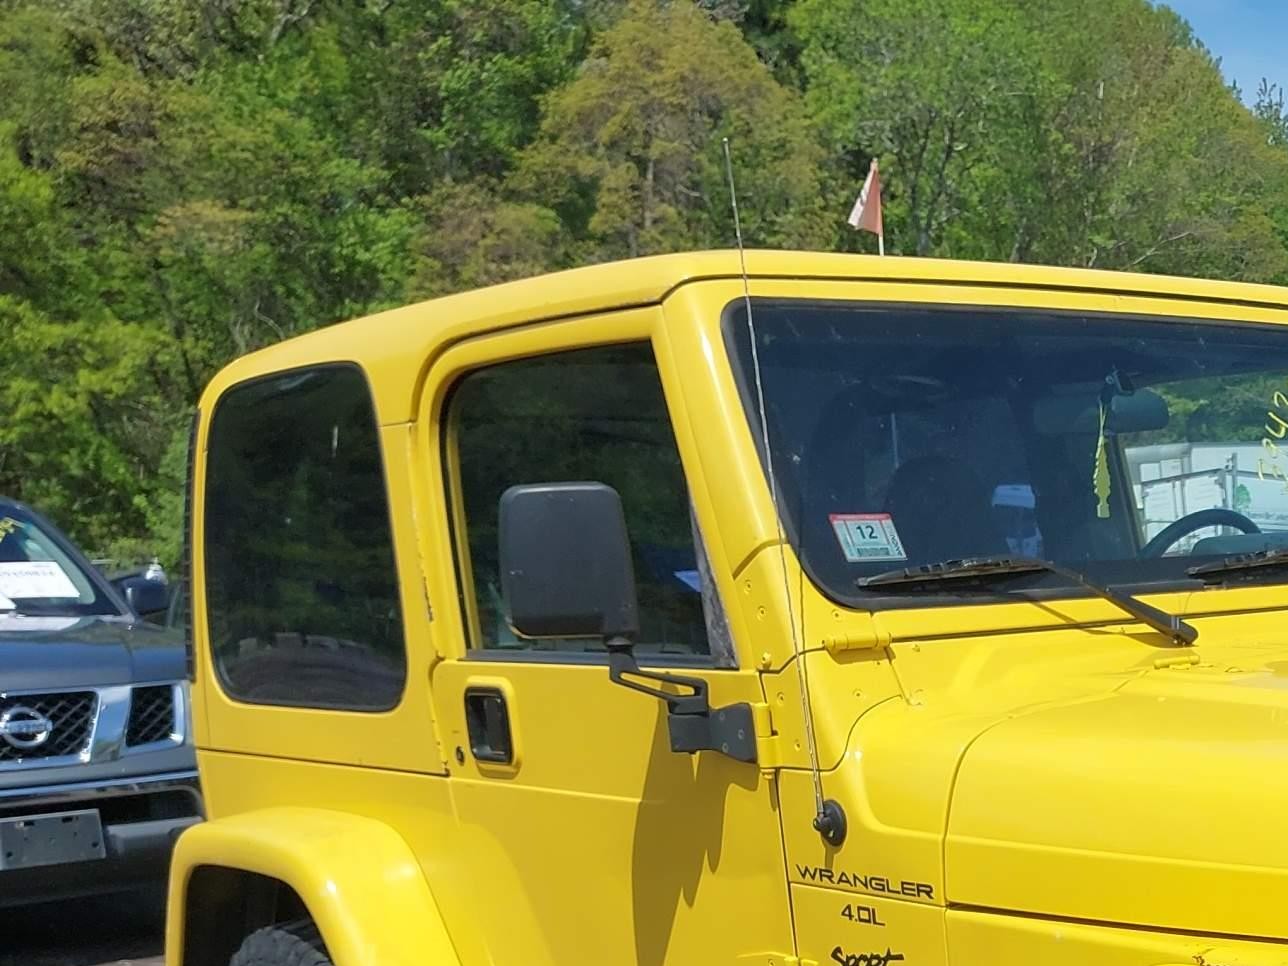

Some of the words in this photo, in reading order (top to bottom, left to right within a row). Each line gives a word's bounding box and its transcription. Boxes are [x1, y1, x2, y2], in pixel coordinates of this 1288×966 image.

[855, 525, 879, 540] 12
[795, 864, 935, 900] WRANGLER
[840, 903, 886, 927] 4.0L
